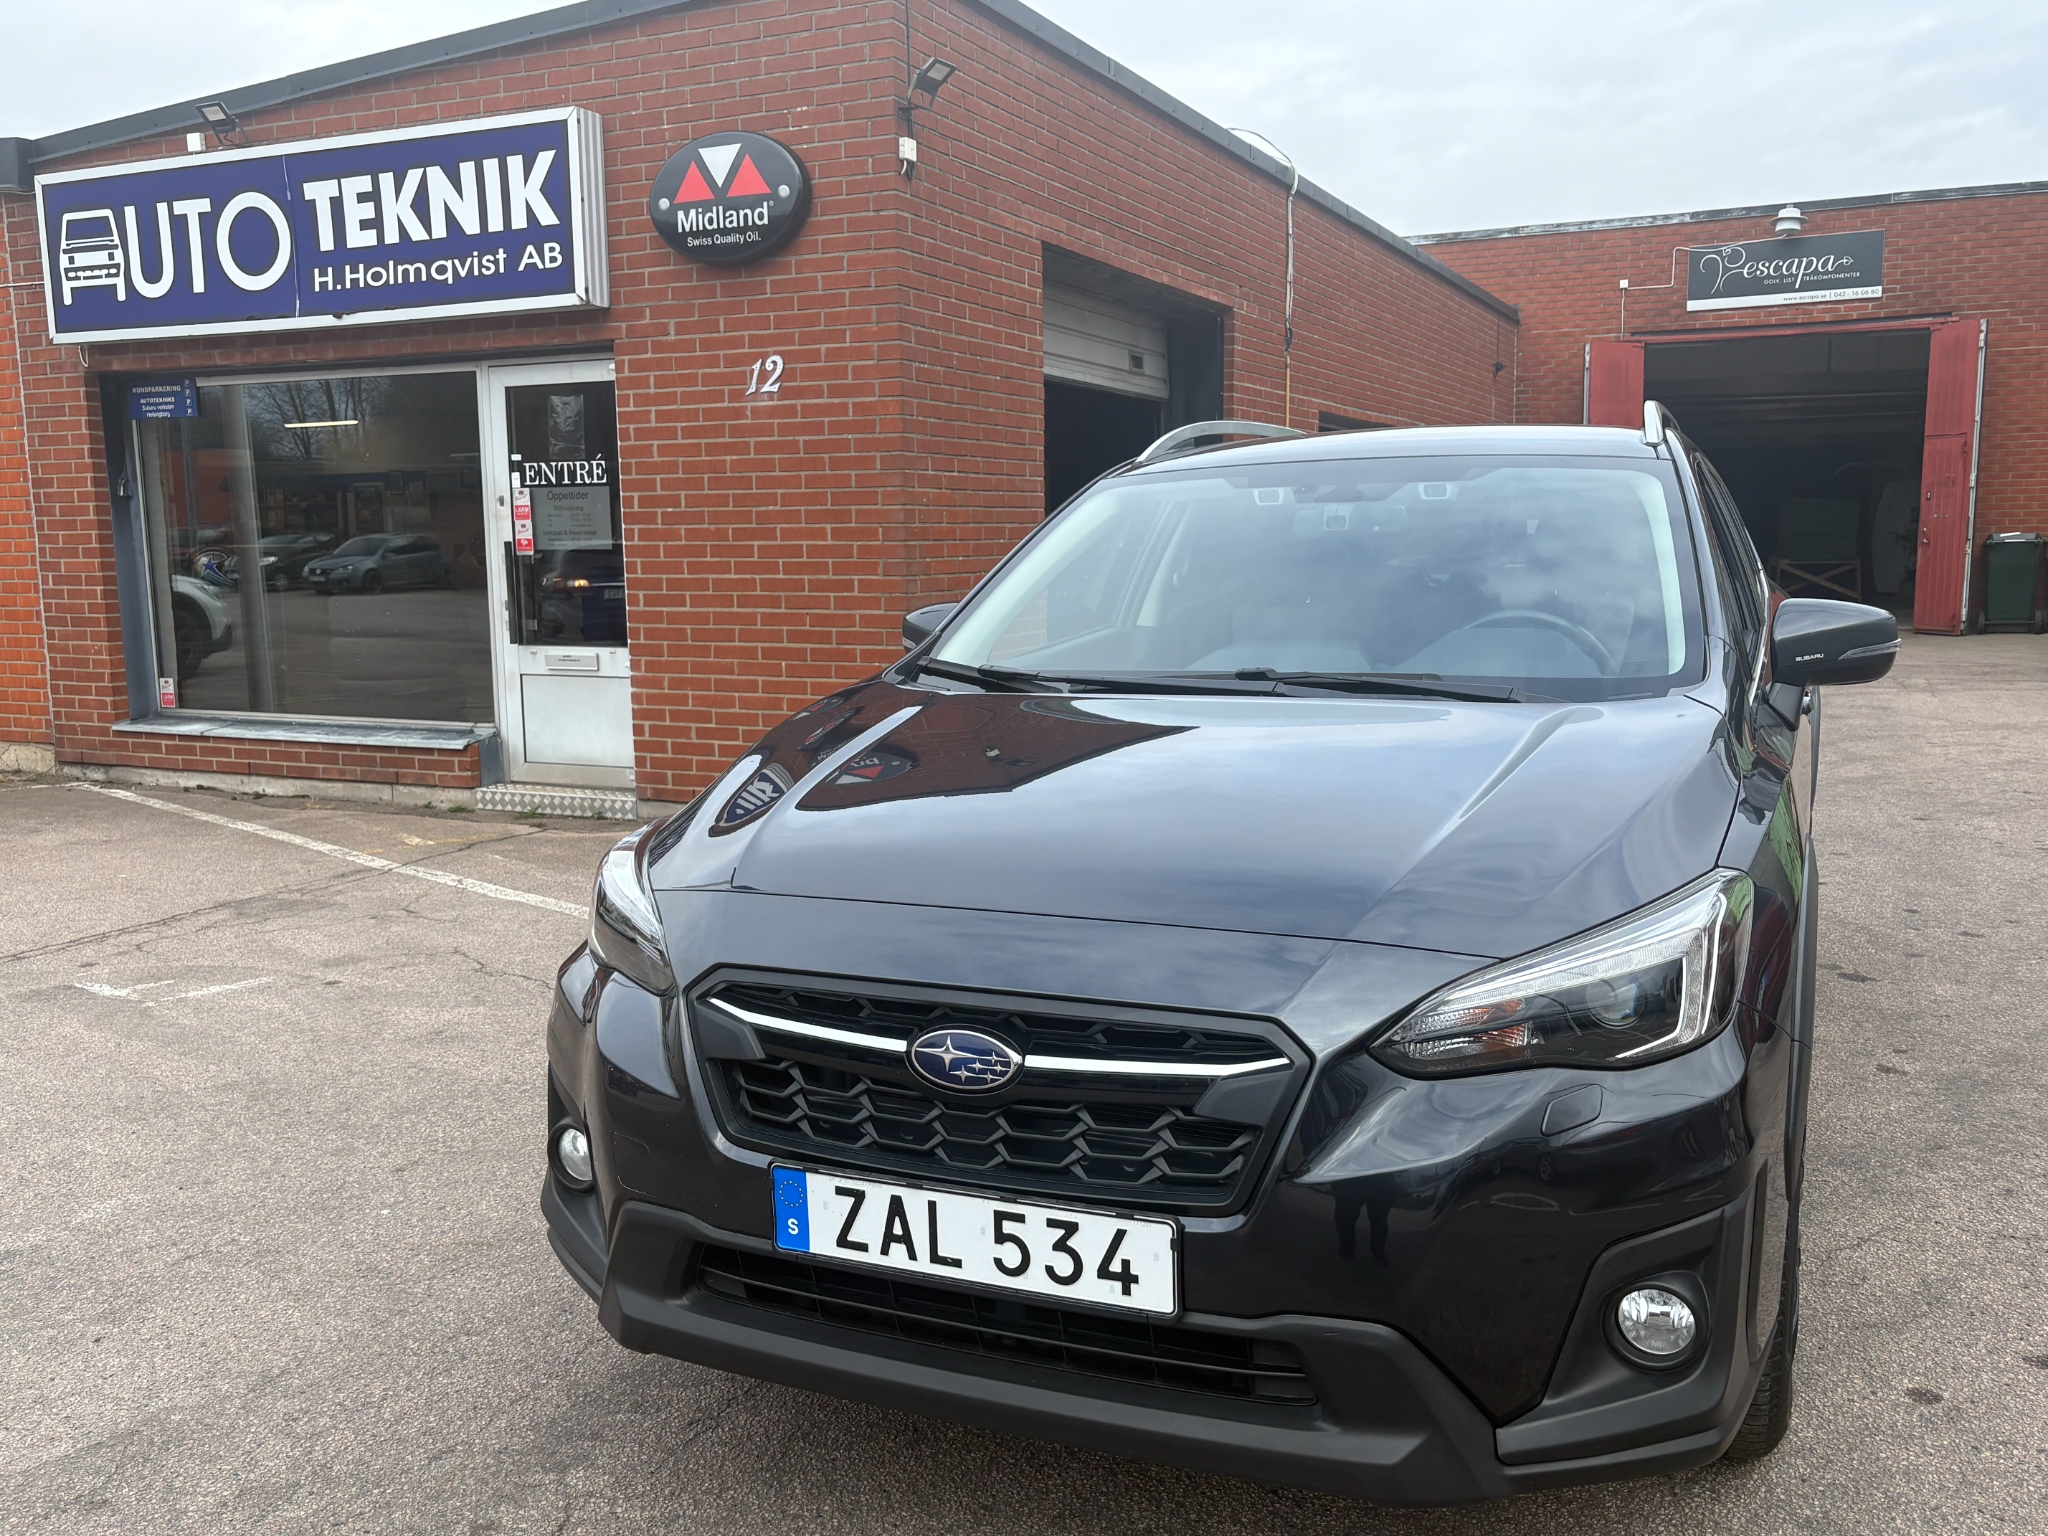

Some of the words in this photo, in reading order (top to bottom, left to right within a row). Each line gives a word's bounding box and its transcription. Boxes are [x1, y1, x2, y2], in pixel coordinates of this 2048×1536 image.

[302, 149, 560, 252] TEKNIK
[677, 202, 770, 233] Midland
[687, 236, 712, 247] Swiss
[713, 234, 745, 246] Quality
[746, 230, 762, 242] Oil.
[314, 248, 506, 293] H.Holmqvist
[518, 242, 562, 272] AB
[132, 385, 181, 393] KUNDPARKERING
[746, 354, 784, 396] 12
[523, 454, 607, 486] ENTRÉ
[546, 490, 589, 502] Öppettider
[1795, 653, 1824, 661] SUBARU
[787, 1217, 799, 1235] S
[834, 1185, 963, 1269] ZAL
[993, 1208, 1140, 1296] 534
